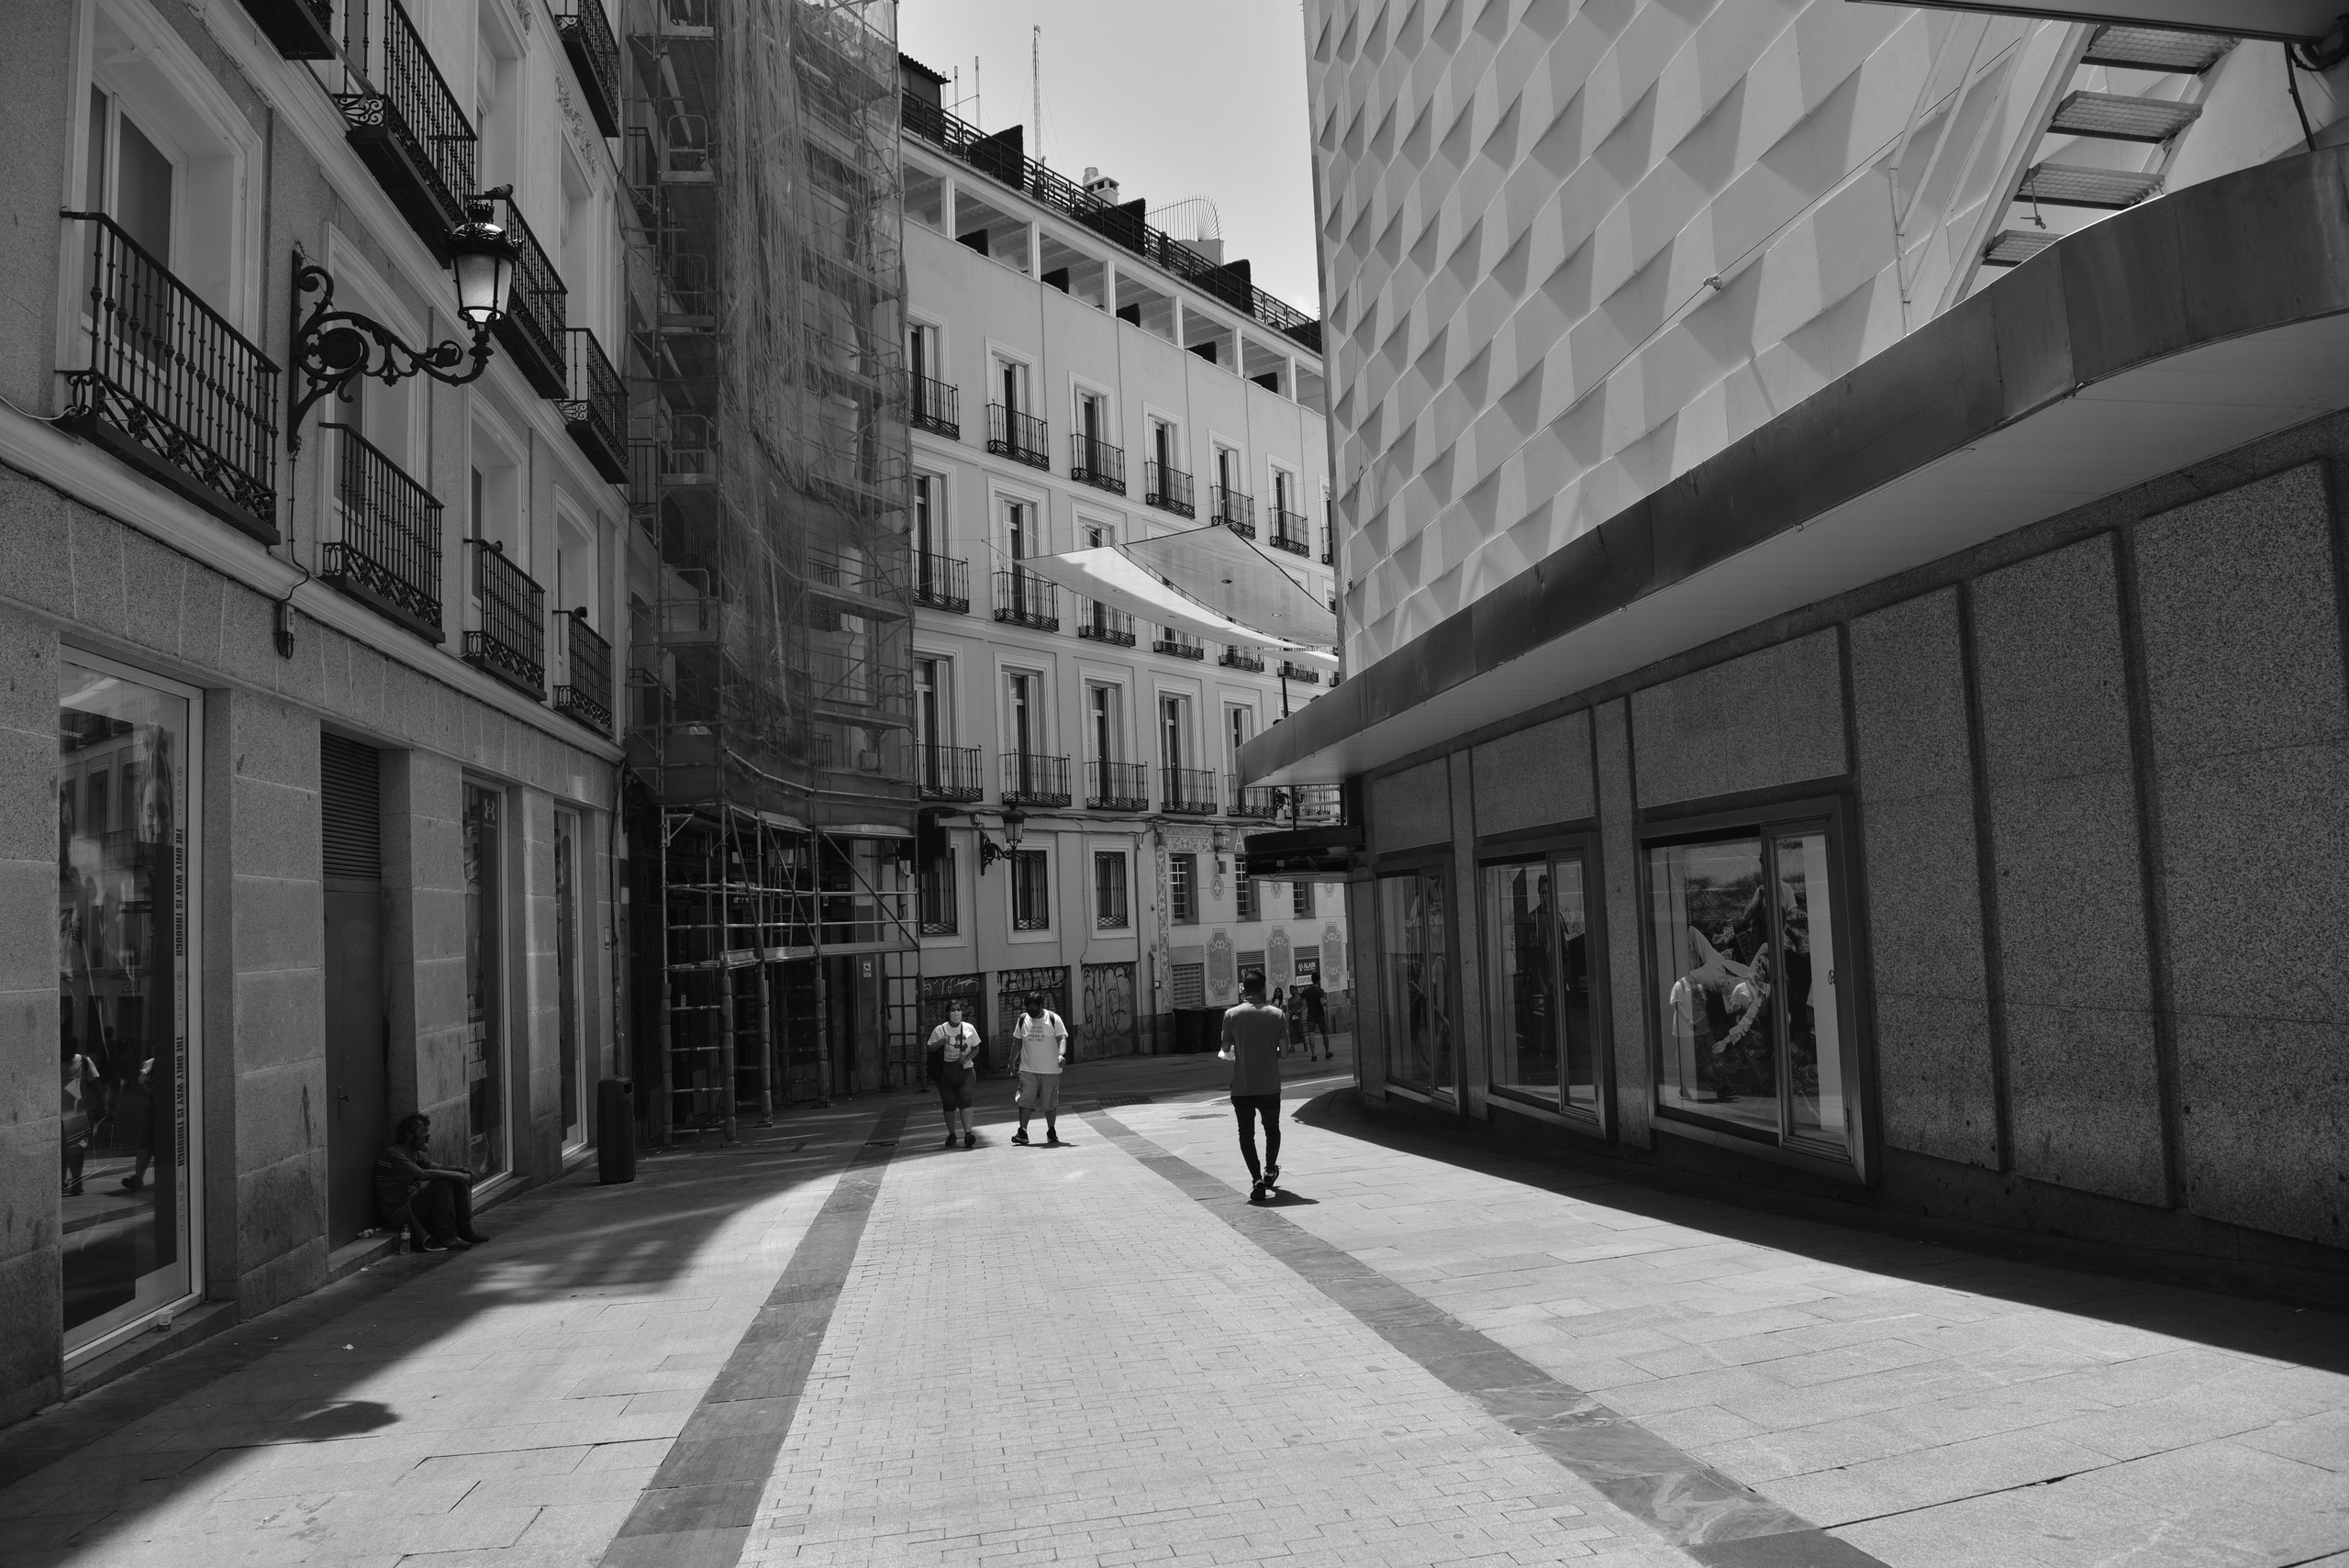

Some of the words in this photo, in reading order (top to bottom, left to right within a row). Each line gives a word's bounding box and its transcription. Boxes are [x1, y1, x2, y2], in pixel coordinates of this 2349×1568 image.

[175, 899, 183, 909] IS
[1304, 961, 1316, 970] ALAIN
[177, 1108, 184, 1118] IS
[177, 1120, 185, 1167] THROUGH
